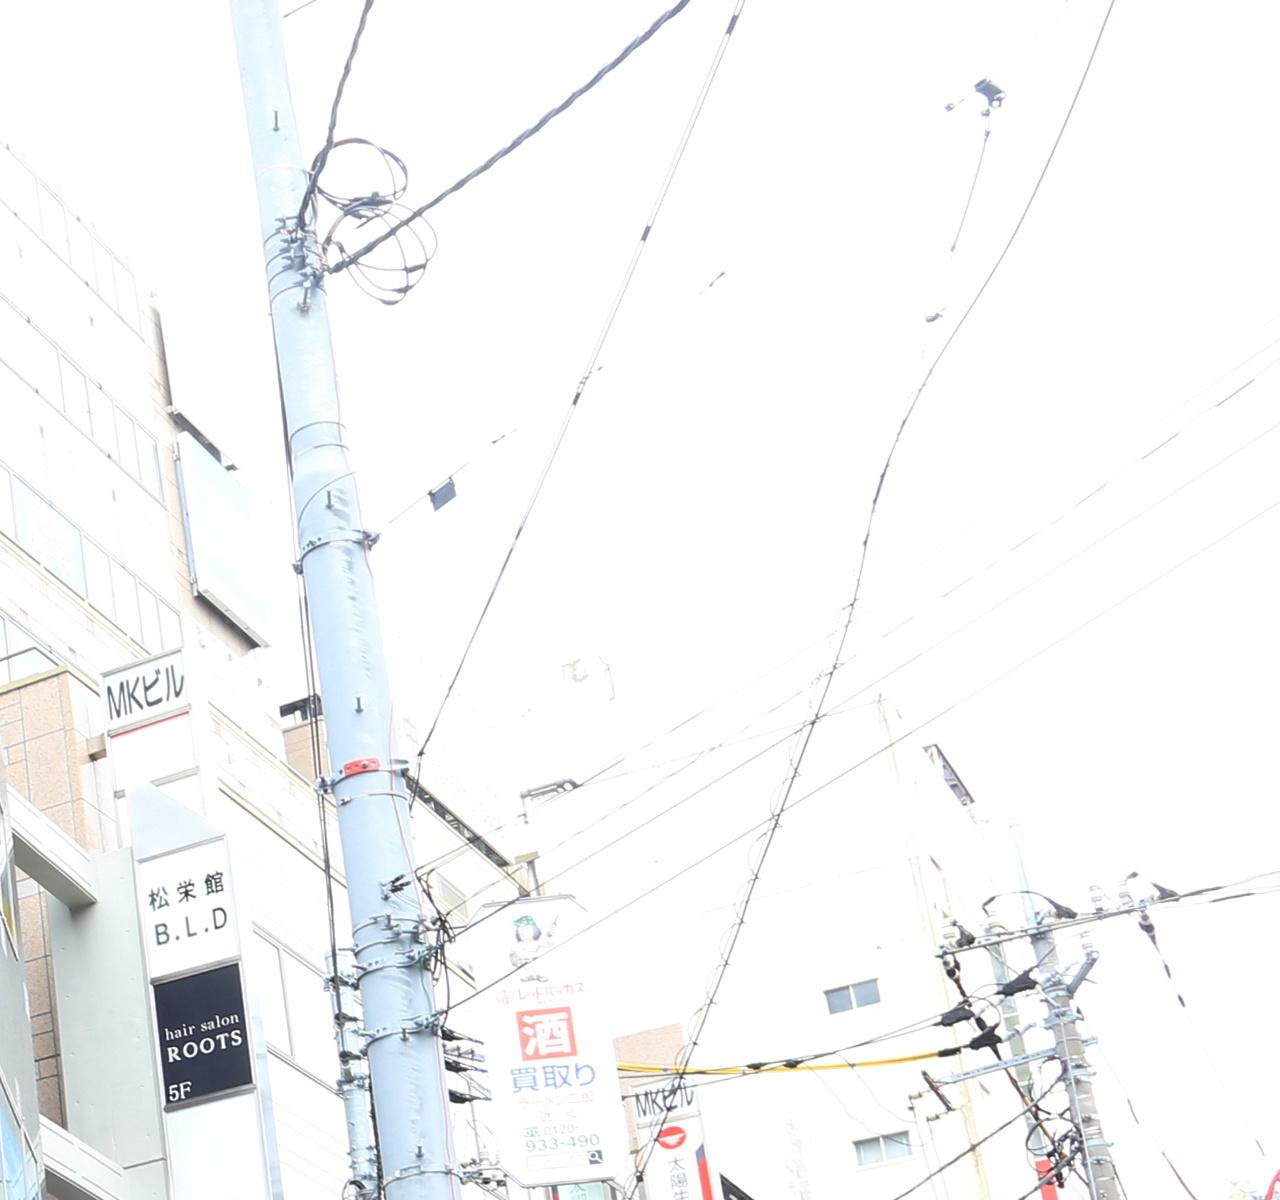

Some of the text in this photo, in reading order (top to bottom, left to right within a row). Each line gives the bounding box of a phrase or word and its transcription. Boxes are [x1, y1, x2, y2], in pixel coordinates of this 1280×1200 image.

[106, 664, 185, 722] MKビル
[147, 870, 225, 912] 松栄館
[154, 908, 228, 947] B.L.D
[164, 1012, 240, 1041] hair salon
[522, 1012, 573, 1056] 酒
[167, 1030, 244, 1064] ROOTS
[168, 1081, 193, 1102] 5F
[509, 1063, 596, 1094] 買取り
[525, 1133, 600, 1152] 933-490
